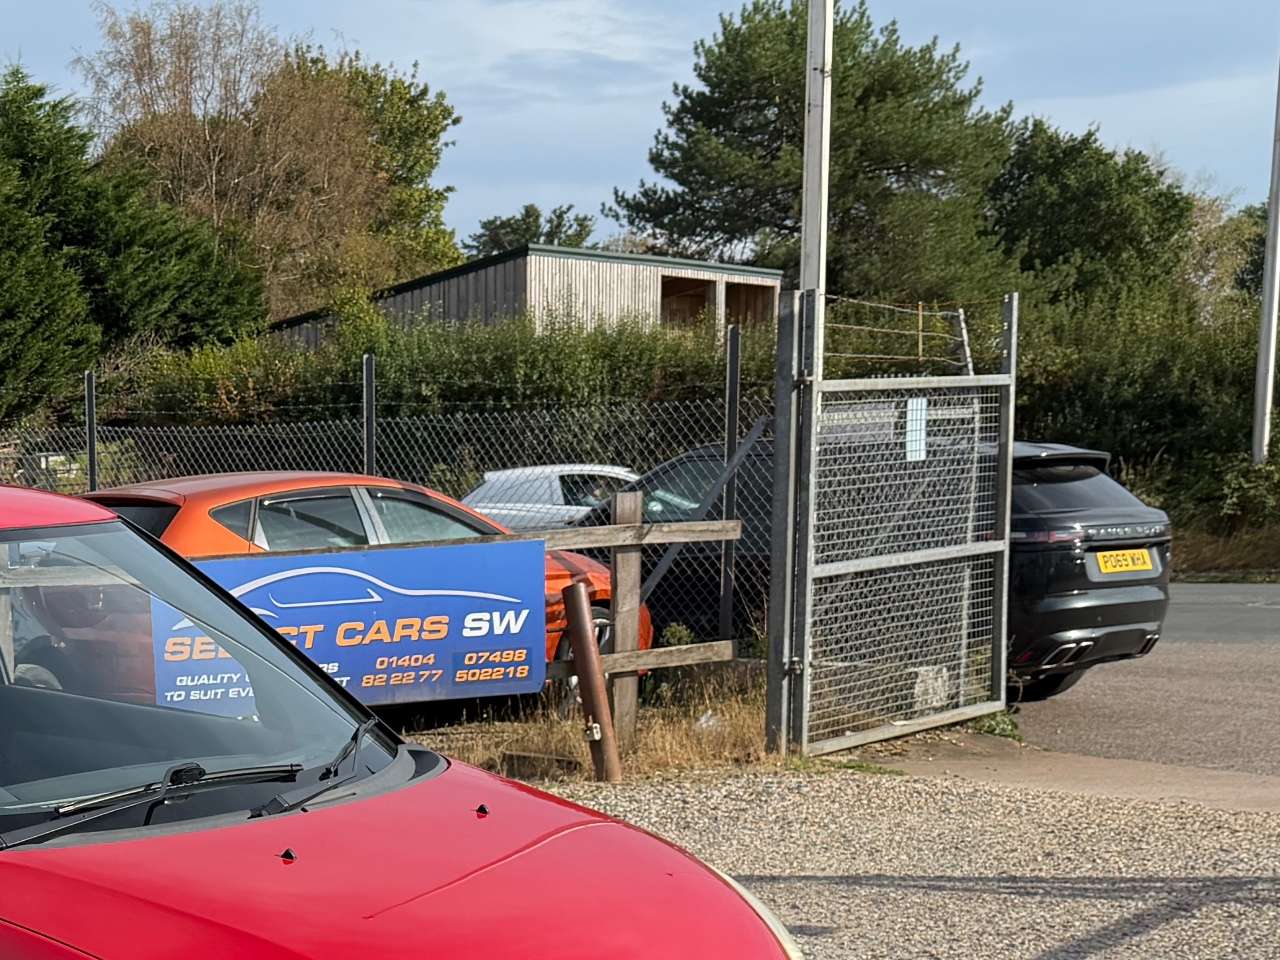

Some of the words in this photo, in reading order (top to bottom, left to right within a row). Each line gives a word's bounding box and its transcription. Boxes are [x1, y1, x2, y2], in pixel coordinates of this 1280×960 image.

[336, 616, 449, 646] CARS
[462, 609, 530, 638] SW
[375, 653, 436, 670] 01404
[464, 649, 528, 666] 07498
[176, 673, 242, 686] QUALITY
[455, 666, 529, 684] 502218
[165, 691, 186, 702] TO
[190, 688, 226, 700] SUIT
